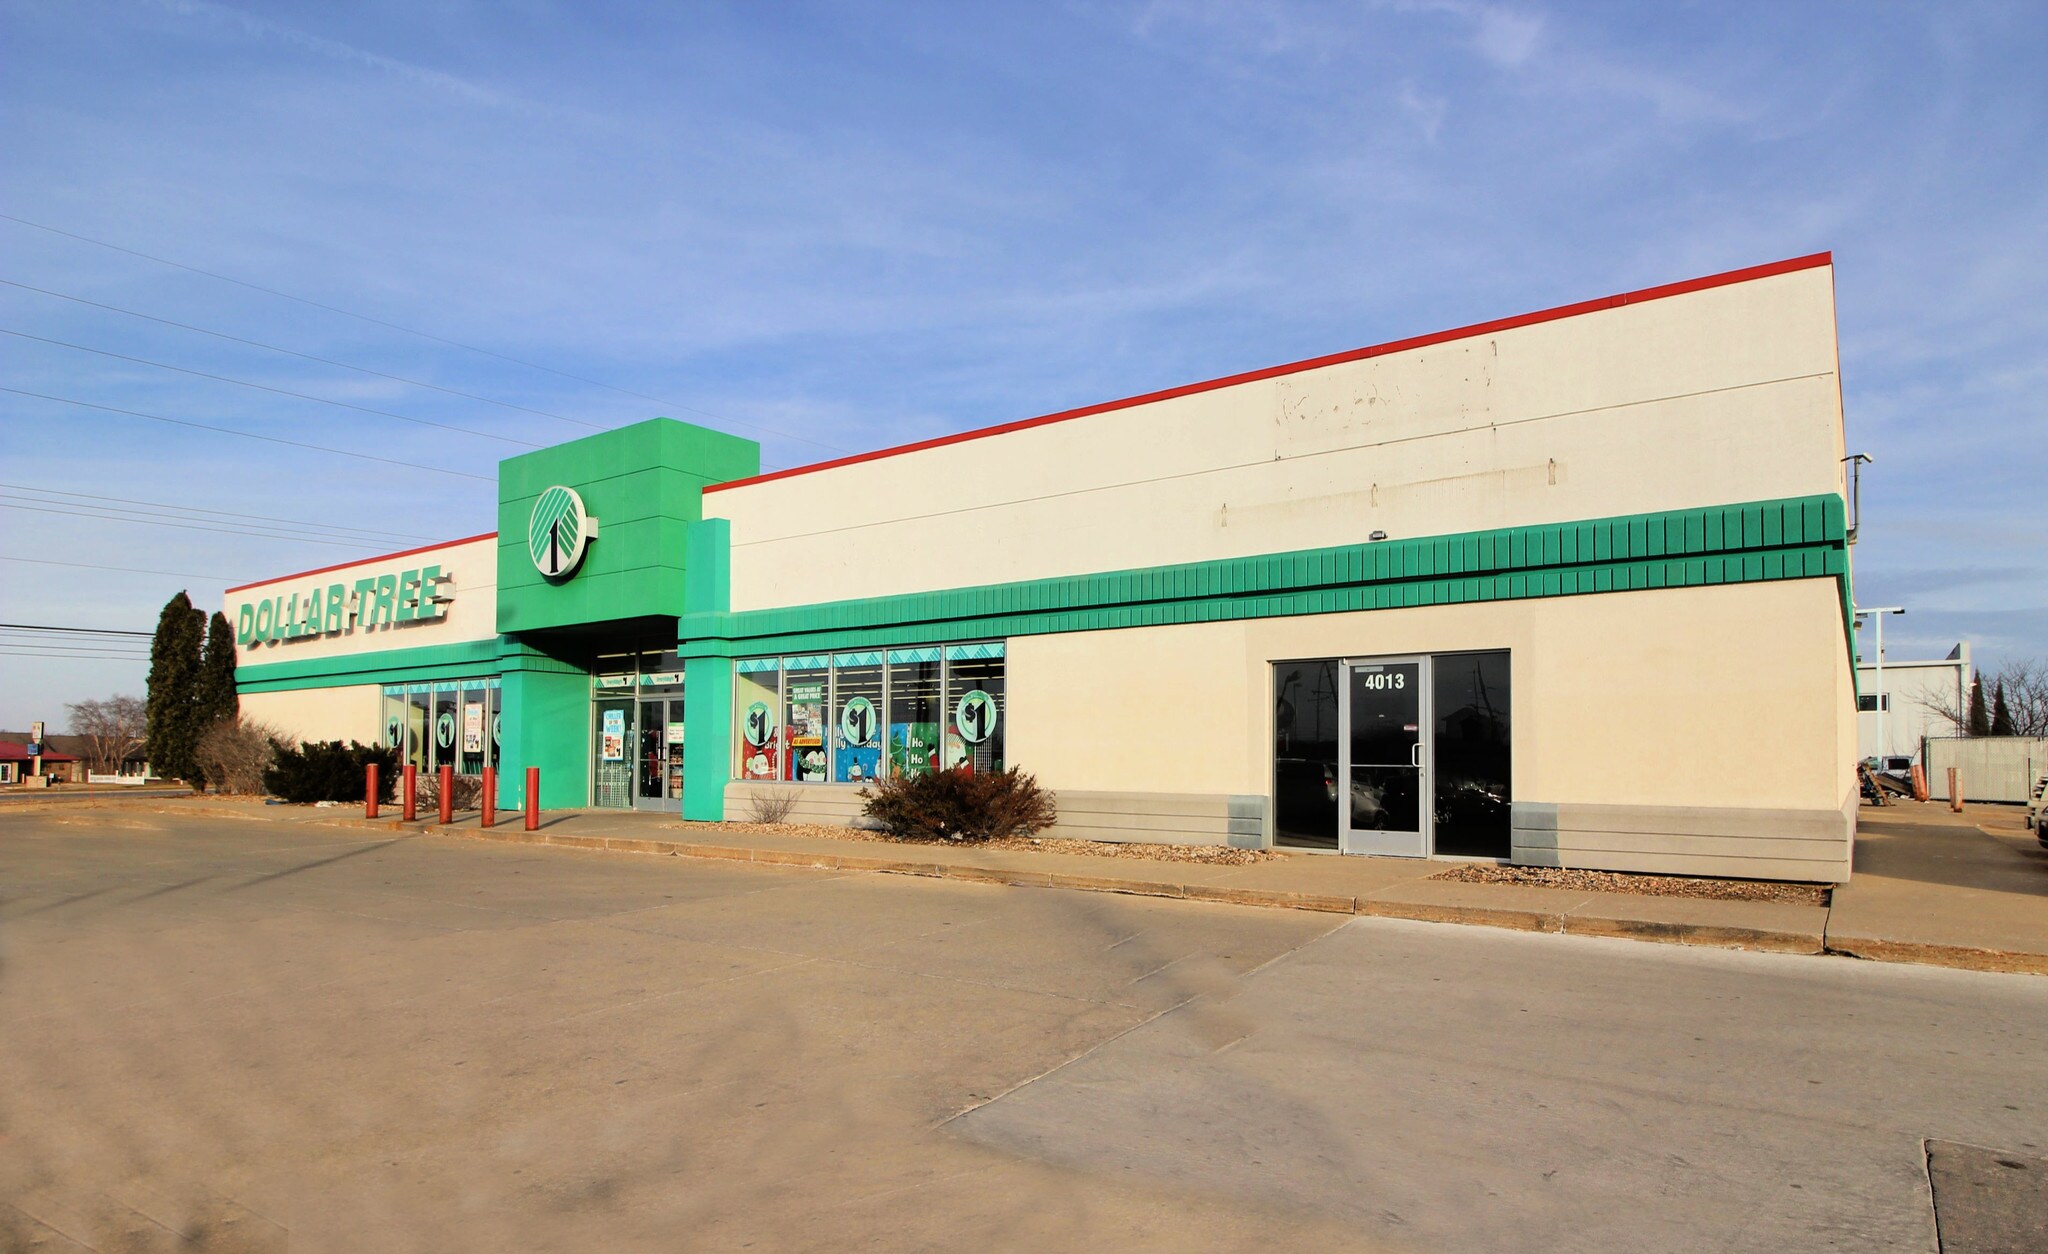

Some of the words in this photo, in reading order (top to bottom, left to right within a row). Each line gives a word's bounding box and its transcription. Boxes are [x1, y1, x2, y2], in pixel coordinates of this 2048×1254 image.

[237, 583, 348, 646] DOLLAR
[355, 565, 445, 628] TREE
[1365, 673, 1405, 690] 4013
[749, 710, 766, 744] $1
[849, 706, 867, 744] $1
[964, 700, 986, 741] $1
[911, 753, 923, 764] Ho
[912, 737, 923, 748] Ho
